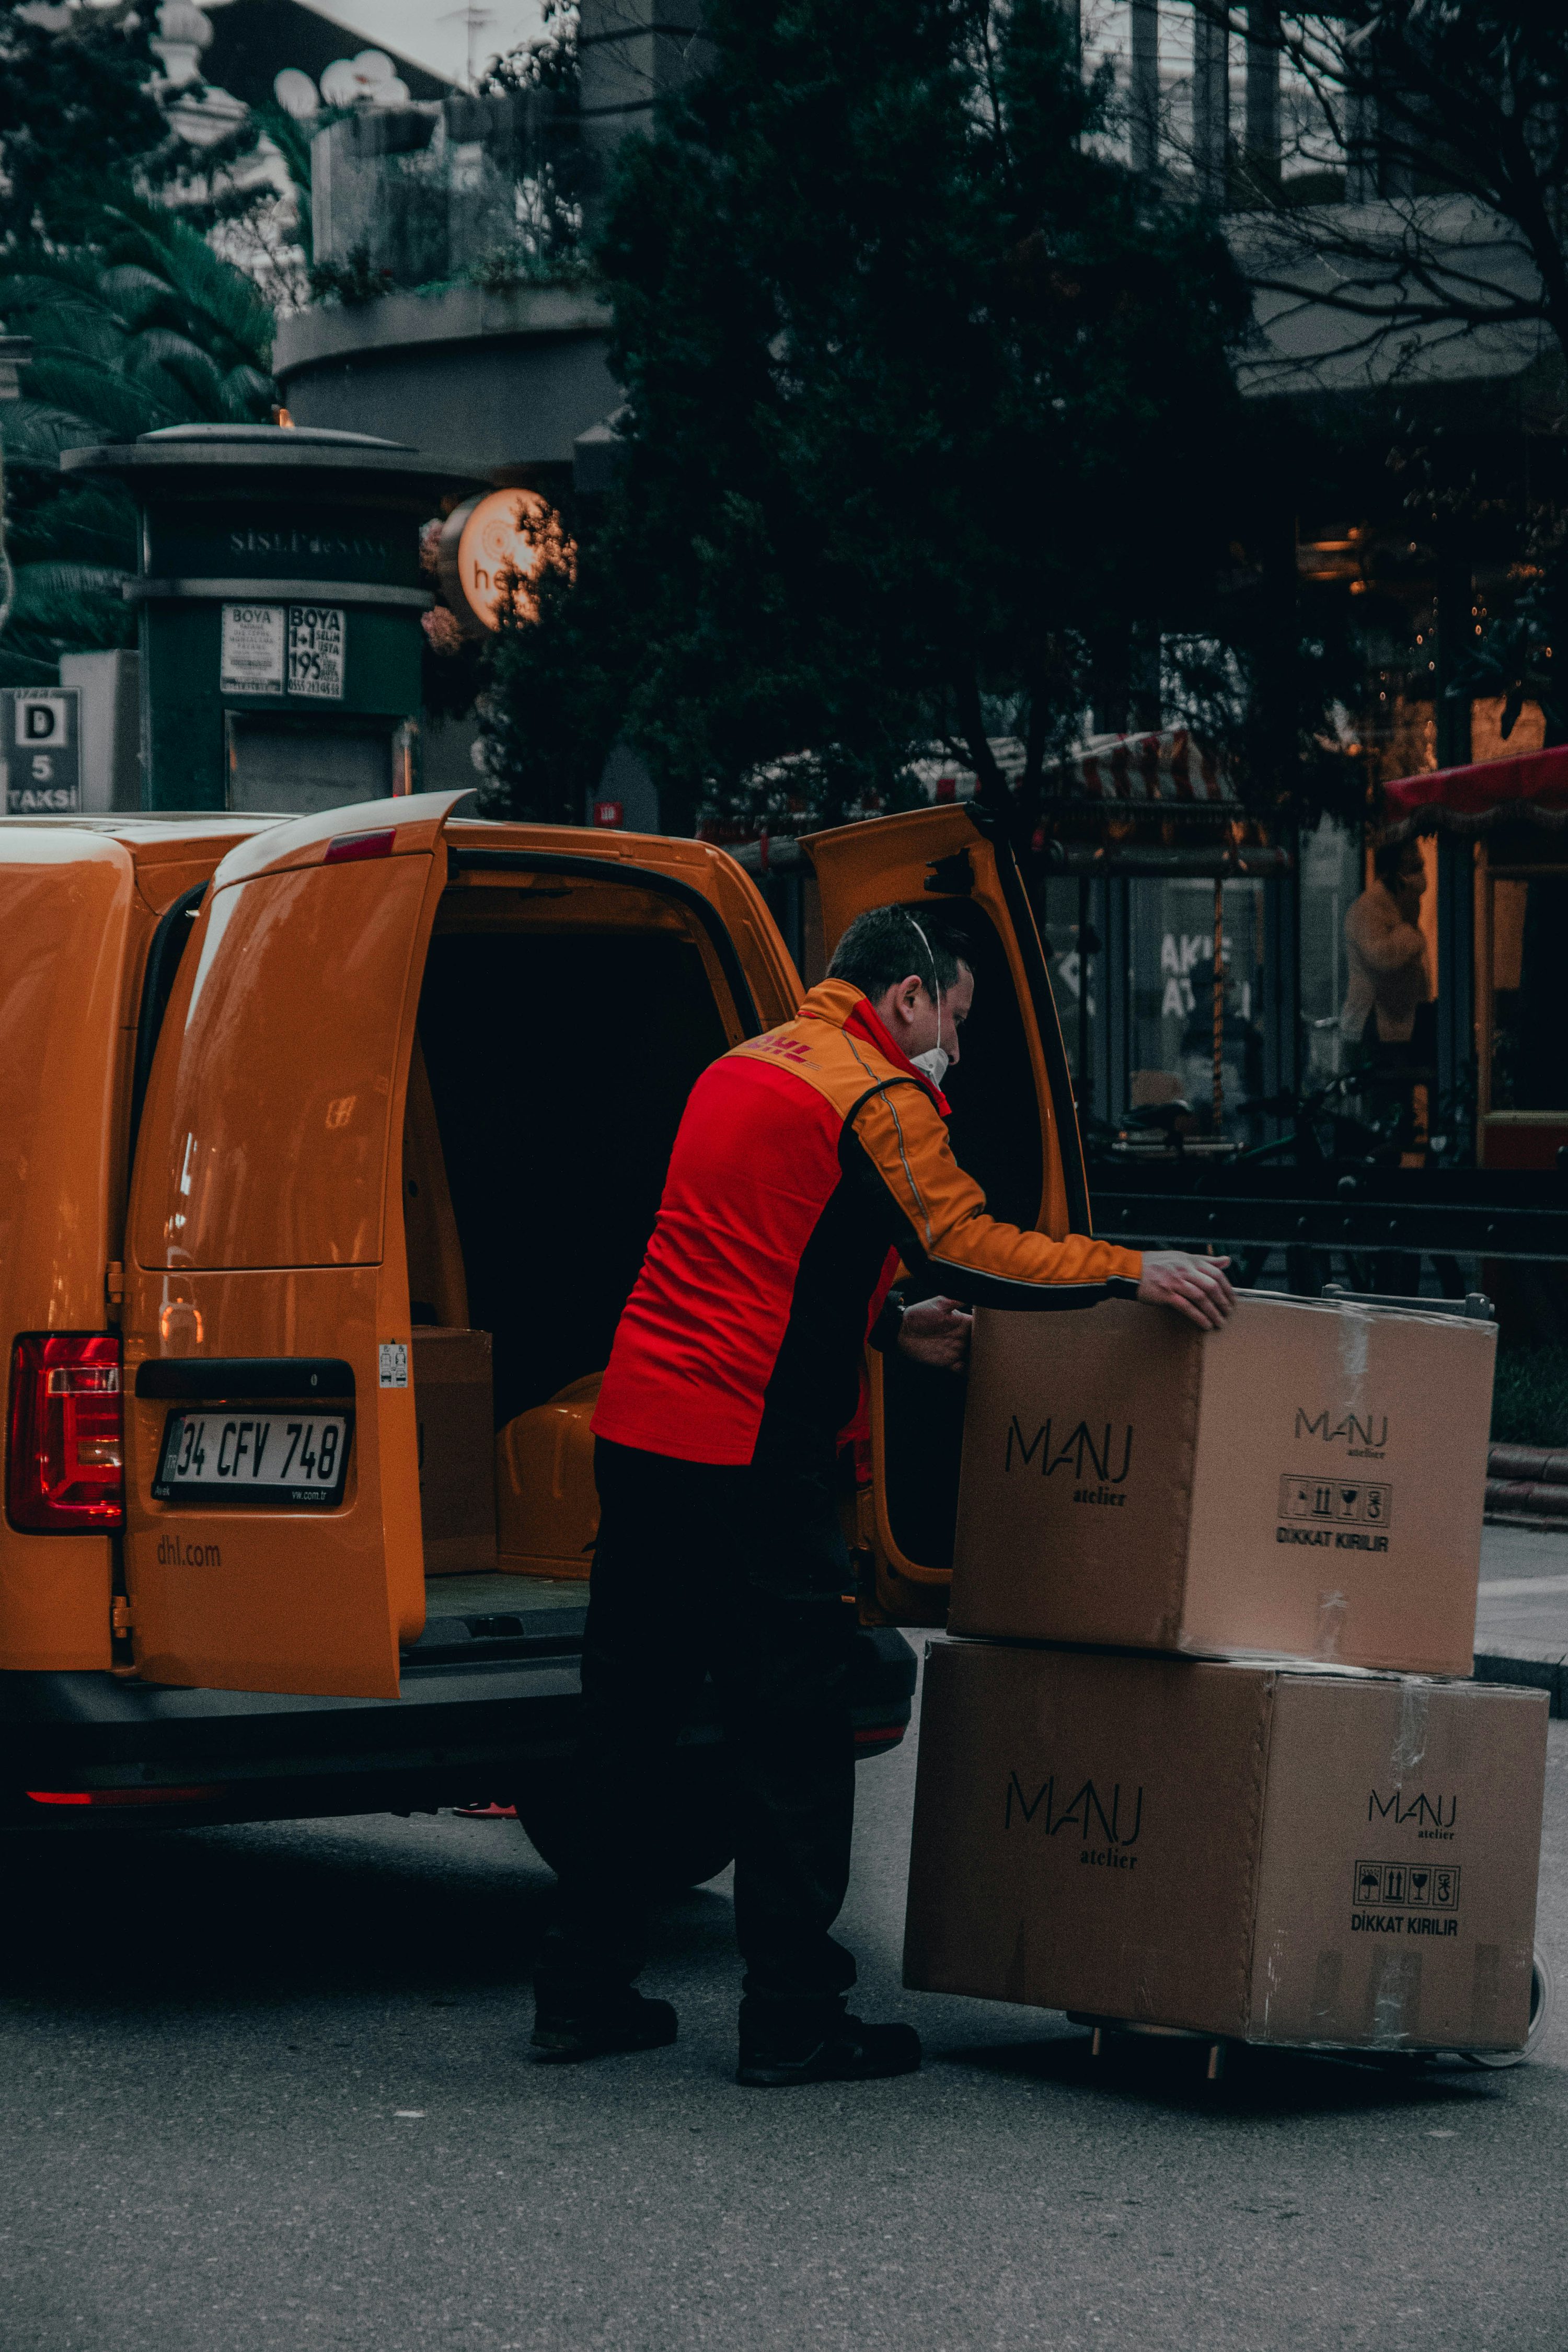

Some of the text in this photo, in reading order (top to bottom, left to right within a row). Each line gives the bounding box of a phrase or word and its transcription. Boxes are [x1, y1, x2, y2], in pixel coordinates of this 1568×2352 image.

[233, 609, 271, 624] BOYA
[289, 607, 340, 631] BOYA
[290, 627, 314, 649] 1+1
[290, 652, 320, 679] 195
[27, 706, 54, 739] D
[32, 754, 52, 781] 5
[8, 785, 77, 809] TAKSİ
[743, 1035, 812, 1064] DHL
[177, 1422, 339, 1479] 34 CFY 748
[1347, 1448, 1385, 1459] atelier
[292, 1490, 327, 1501] vw.com.tr
[1074, 1486, 1127, 1506] atelier
[157, 1535, 221, 1566] dhl.com
[1336, 1532, 1388, 1552] KIRILIR
[1417, 1829, 1455, 1840] atelier
[1080, 1848, 1138, 1869] atelier
[1352, 1910, 1458, 1936] DİKKAT KIRILIR
